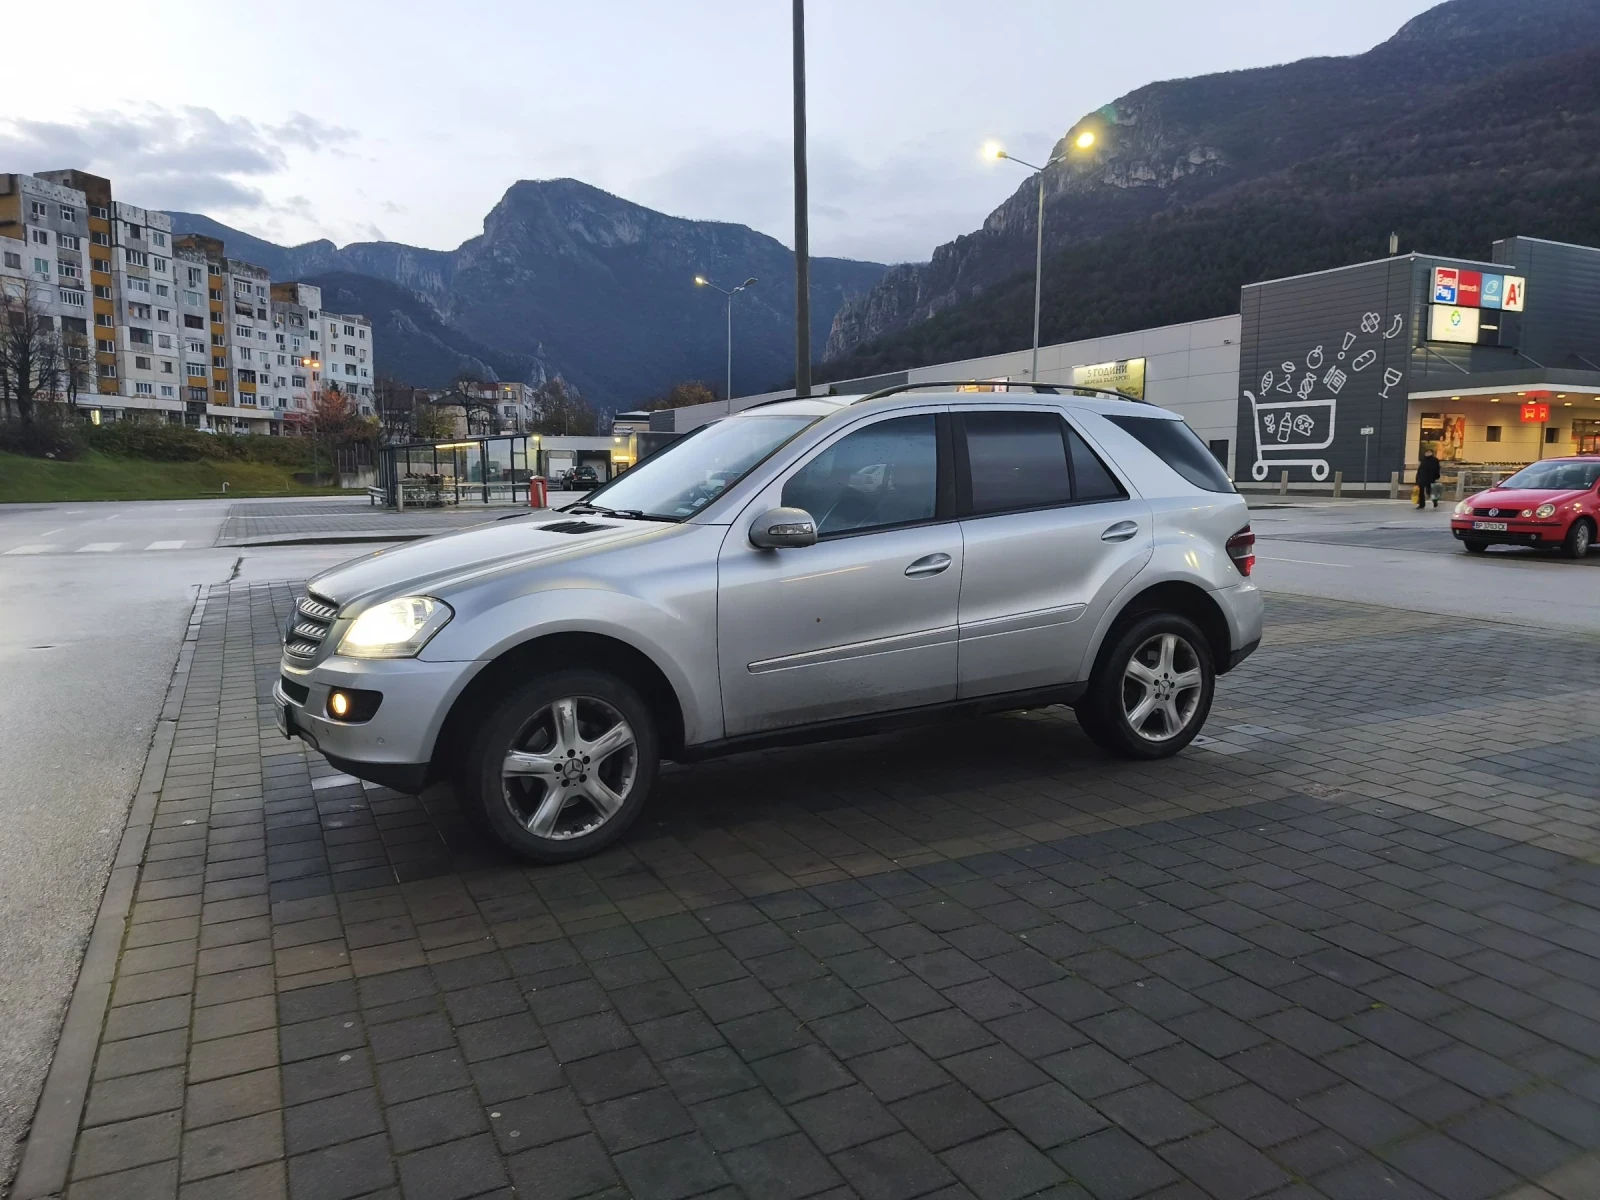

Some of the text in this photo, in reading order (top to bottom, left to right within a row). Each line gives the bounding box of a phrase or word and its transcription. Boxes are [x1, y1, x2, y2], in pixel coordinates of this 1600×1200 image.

[1437, 273, 1456, 288] Easy
[1437, 286, 1452, 300] Pay
[1505, 282, 1522, 305] A1
[1087, 365, 1128, 378] 5 ГОДИНИ
